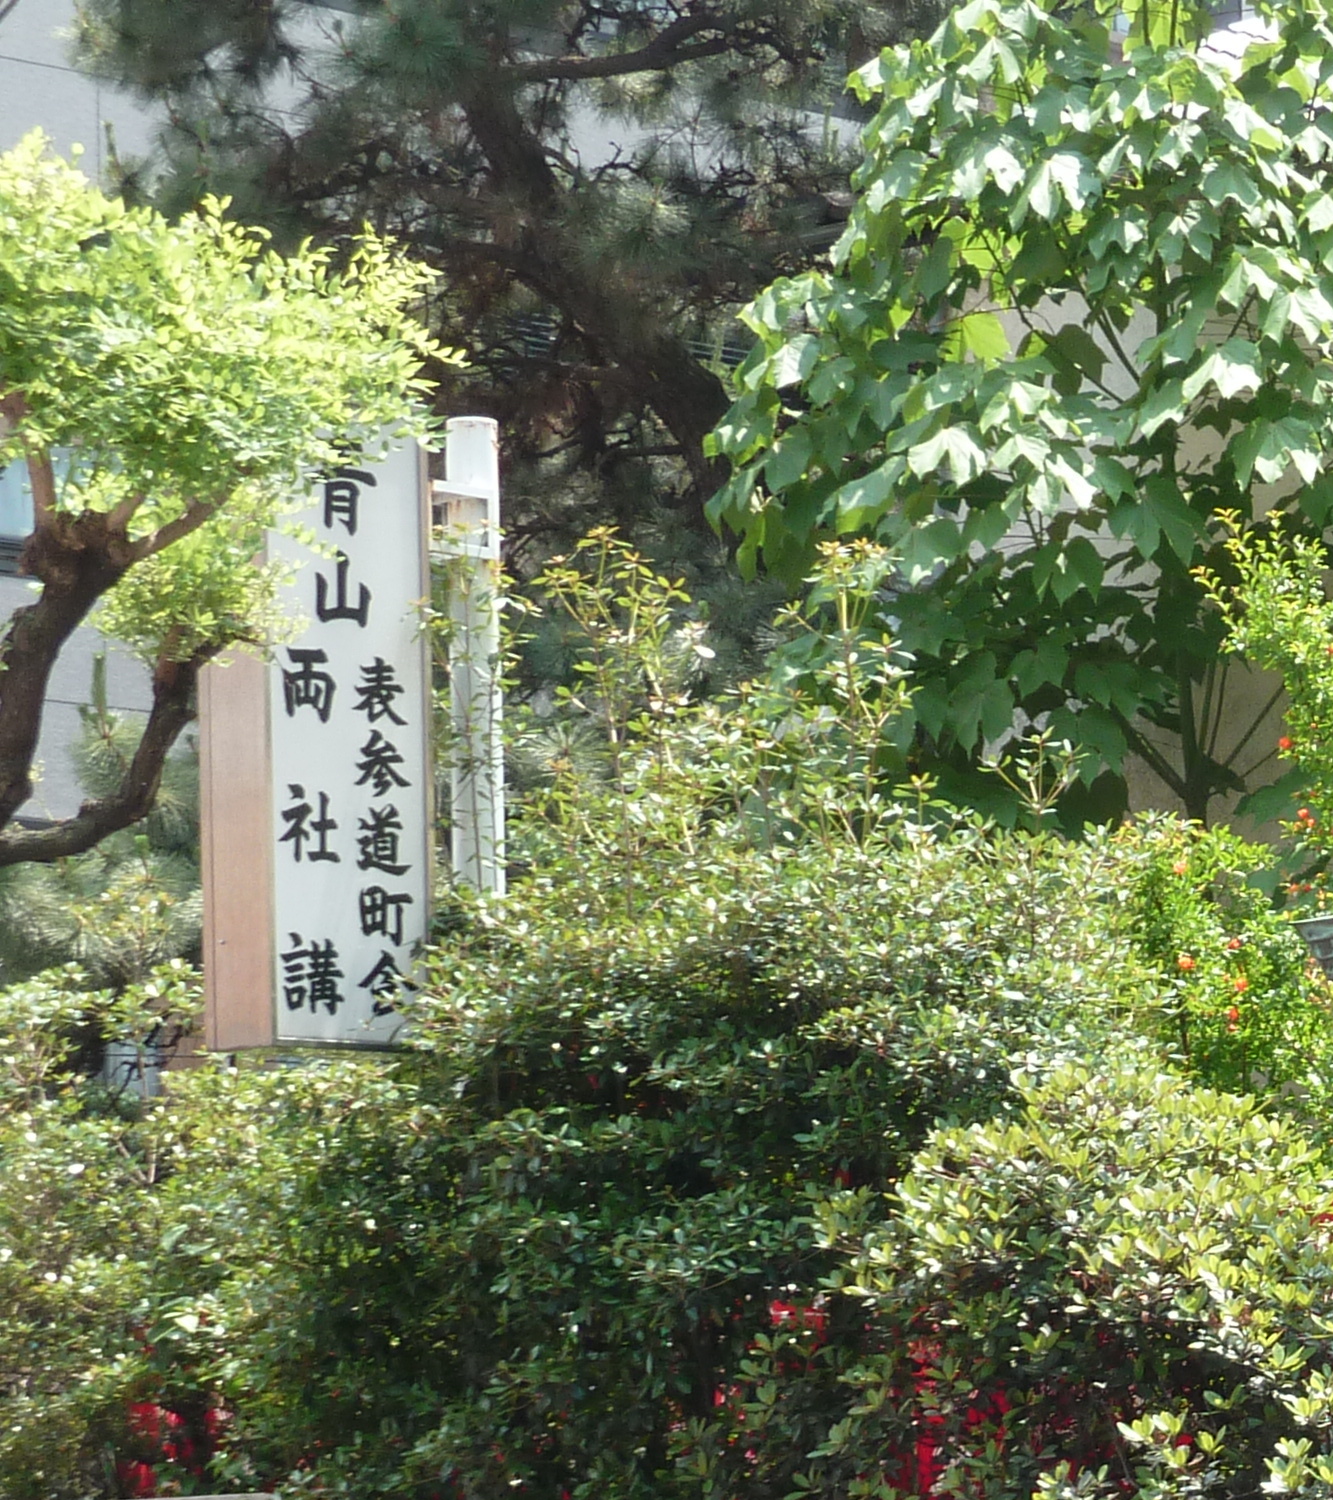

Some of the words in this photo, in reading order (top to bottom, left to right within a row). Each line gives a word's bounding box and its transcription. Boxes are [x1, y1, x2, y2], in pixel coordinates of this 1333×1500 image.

[278, 647, 344, 1016] 両社講
[353, 656, 419, 1016] 表参道町会
